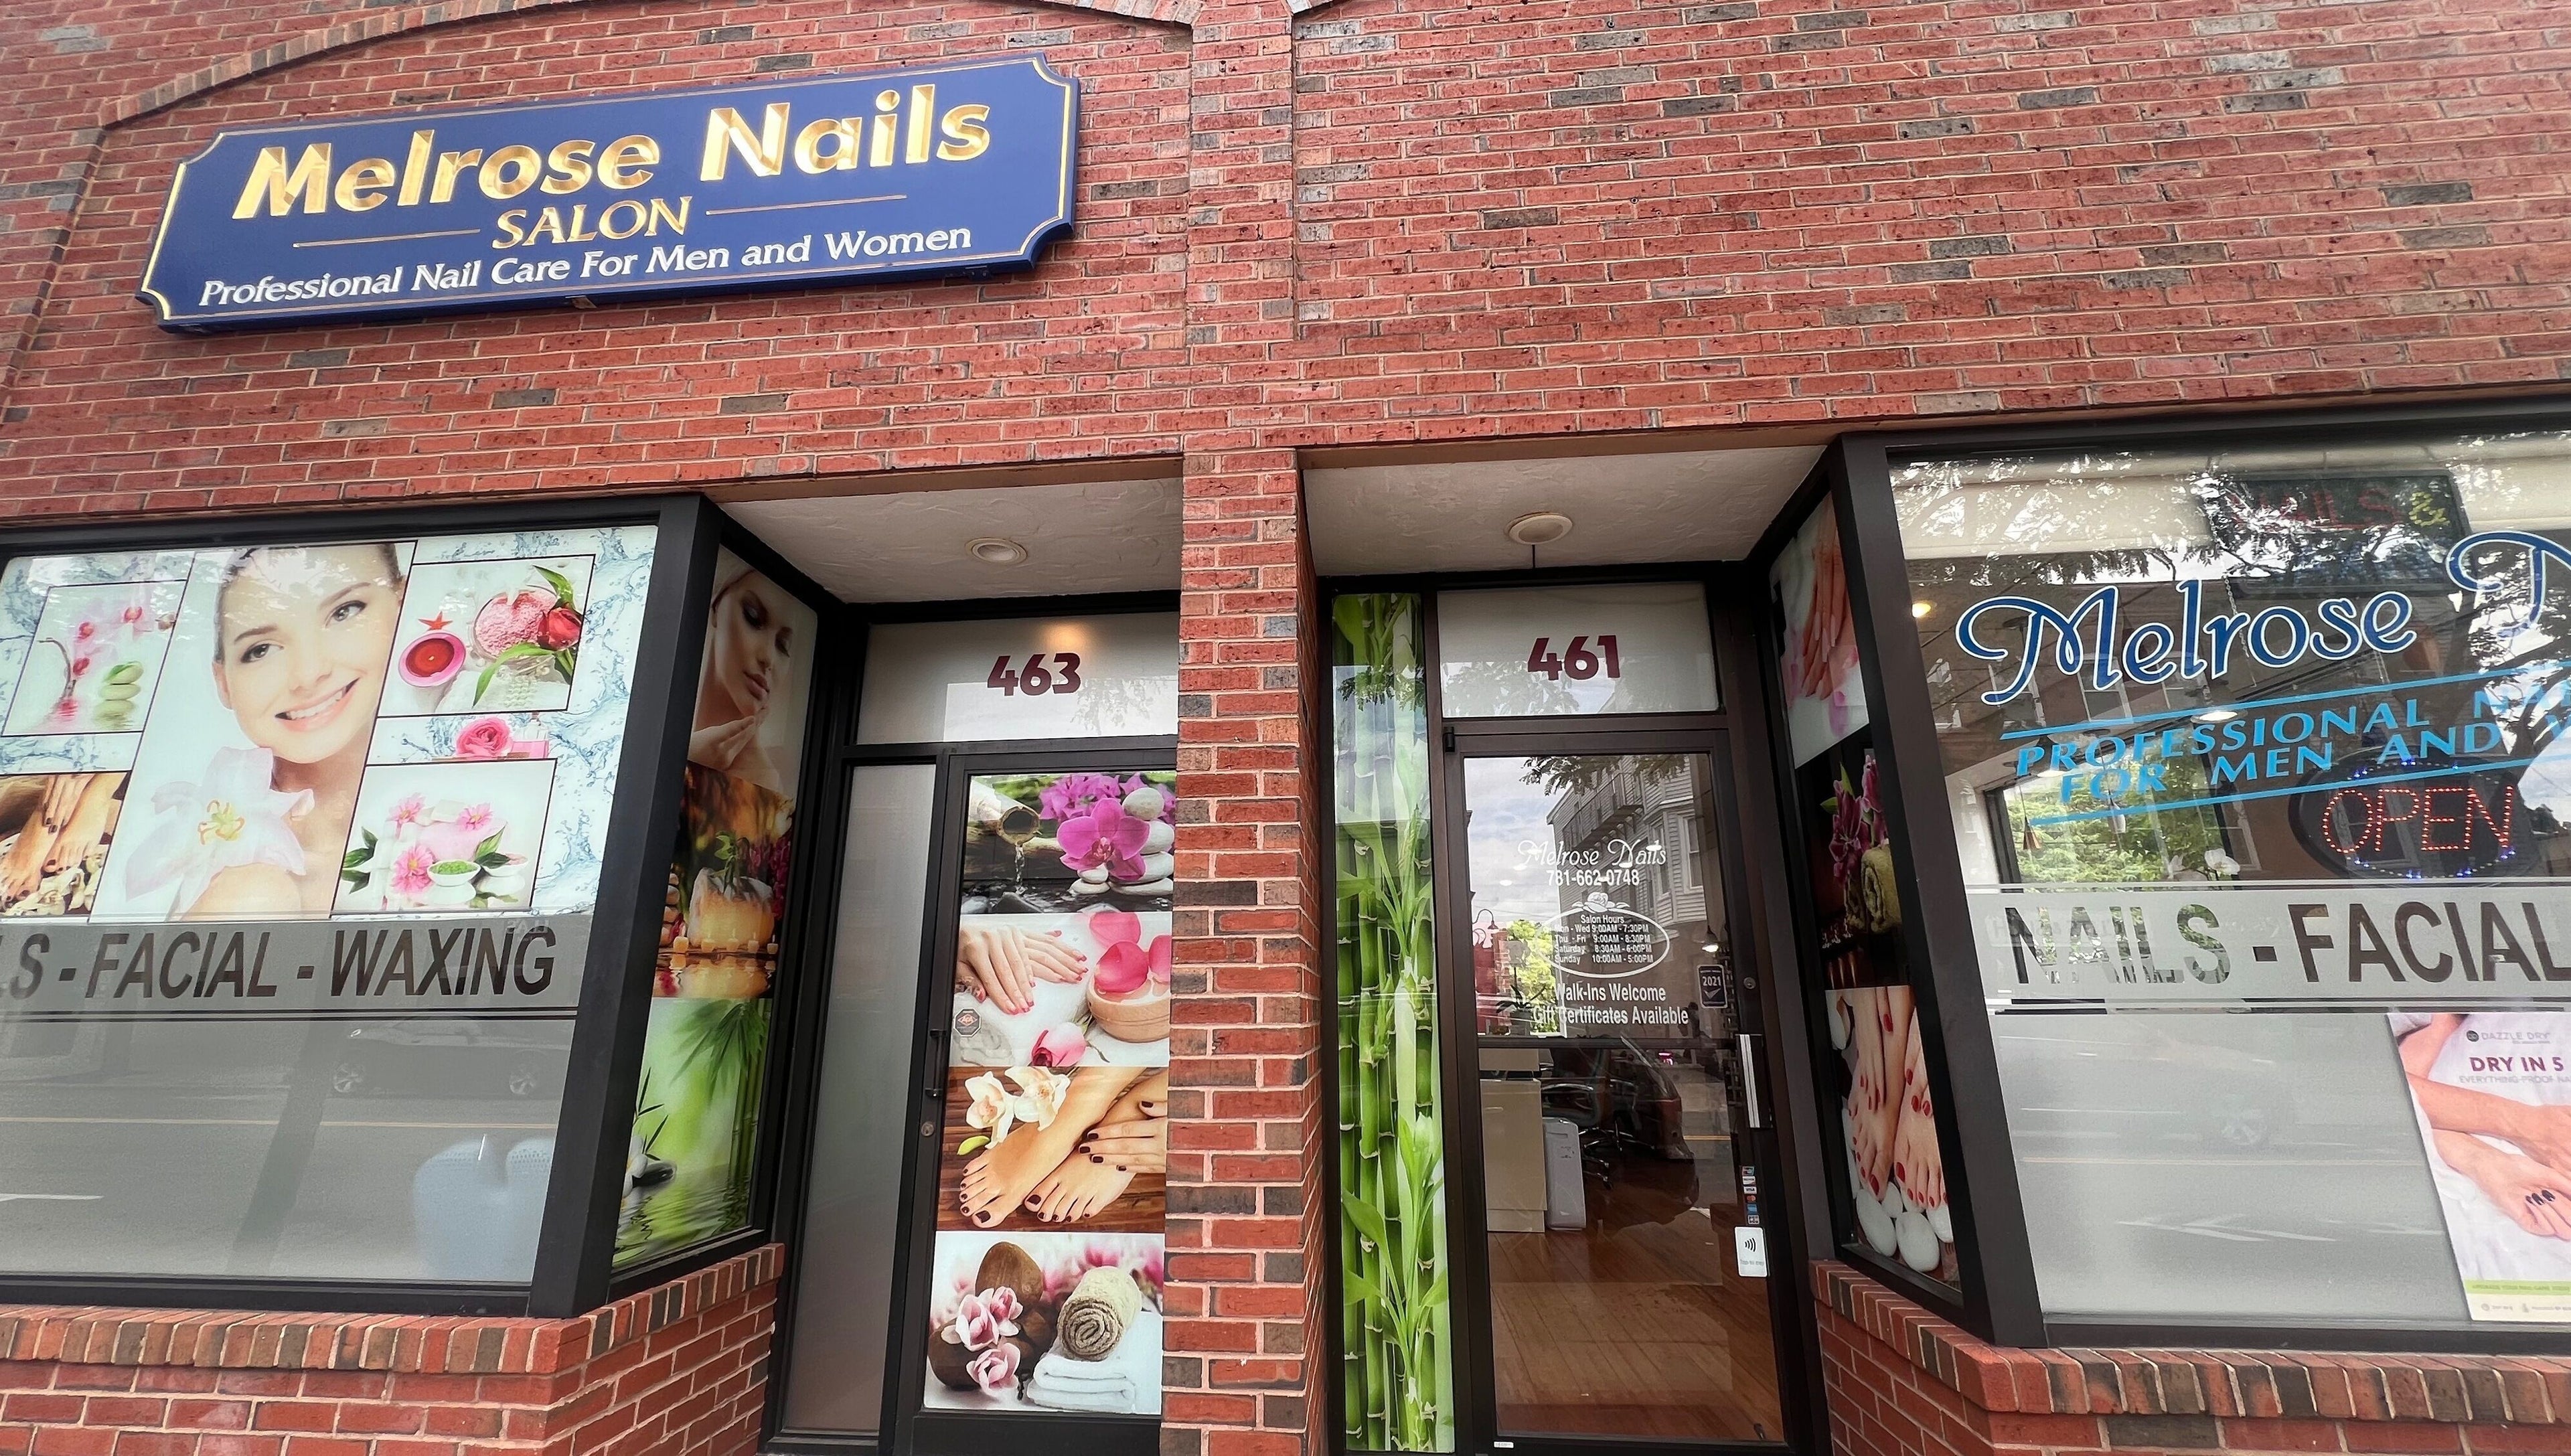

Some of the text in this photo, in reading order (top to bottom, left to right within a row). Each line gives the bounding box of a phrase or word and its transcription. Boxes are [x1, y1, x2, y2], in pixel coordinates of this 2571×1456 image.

[232, 83, 991, 220] Melrose Nails
[492, 195, 692, 248] SALON
[198, 227, 971, 306] Professional Nail Care For Men and Women
[1955, 579, 2416, 704] Melrose
[1527, 635, 1621, 680] 461
[988, 652, 1081, 696] 463
[2016, 698, 2430, 777] PROFESSIONAL
[2060, 764, 2167, 805] FOR
[2211, 742, 2333, 785] MEN
[2377, 722, 2501, 764] AND
[2322, 785, 2515, 854] OPEN
[1518, 839, 1666, 866] Melrose Nails
[1547, 869, 1640, 886] 781-662-0748
[1575, 924, 1590, 933] Wed
[1591, 924, 1618, 933] 9:00AM
[1624, 924, 1648, 933] 7:30PM
[1581, 914, 1624, 923] Salon Hours
[1555, 945, 1585, 955] Saturday
[1577, 935, 1586, 943] Fri
[1593, 935, 1619, 943] 9:00AM
[1625, 935, 1650, 943] 8:30PM
[2005, 903, 2231, 985] NAILS
[0, 933, 50, 1000] S
[85, 931, 277, 999] FACIAL
[331, 926, 556, 997] WAXING
[1555, 955, 1581, 965] Sunday
[1628, 955, 1653, 963] 5:00PM
[1556, 983, 1666, 1001] Walk-Ins Welcome
[1702, 976, 1721, 986] 2021
[1533, 1005, 1689, 1024] Gift Certificates Available
[2481, 1032, 2550, 1040] DAZZLE DRY
[2469, 1056, 2564, 1072] DRY IN 5
